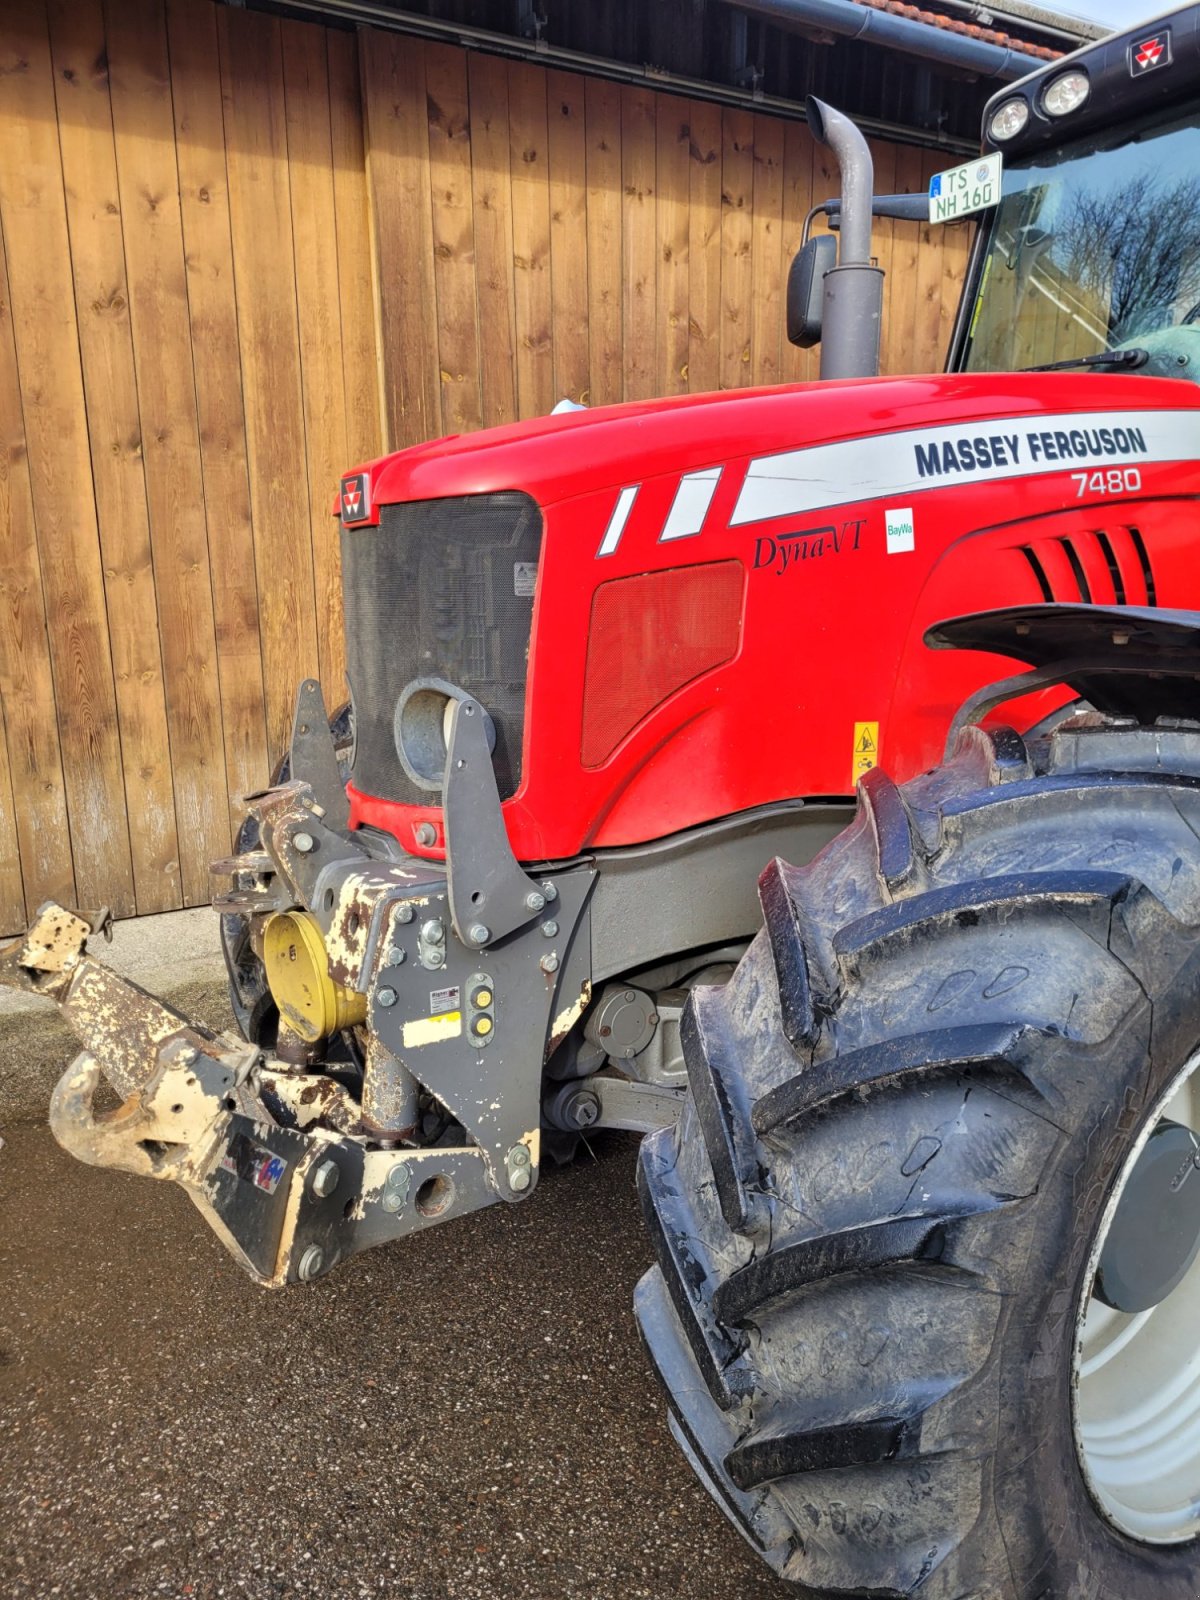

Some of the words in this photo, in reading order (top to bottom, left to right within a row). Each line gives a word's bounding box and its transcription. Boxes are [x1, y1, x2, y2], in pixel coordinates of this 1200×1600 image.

[948, 169, 967, 192] TS
[936, 195, 957, 219] NH
[962, 183, 992, 211] 160
[914, 434, 1019, 477] MASSEY
[1026, 427, 1148, 462] FERGUSON
[1071, 468, 1142, 498] 7480
[887, 523, 913, 537] BayWa
[752, 519, 867, 576] Dyna-VT
